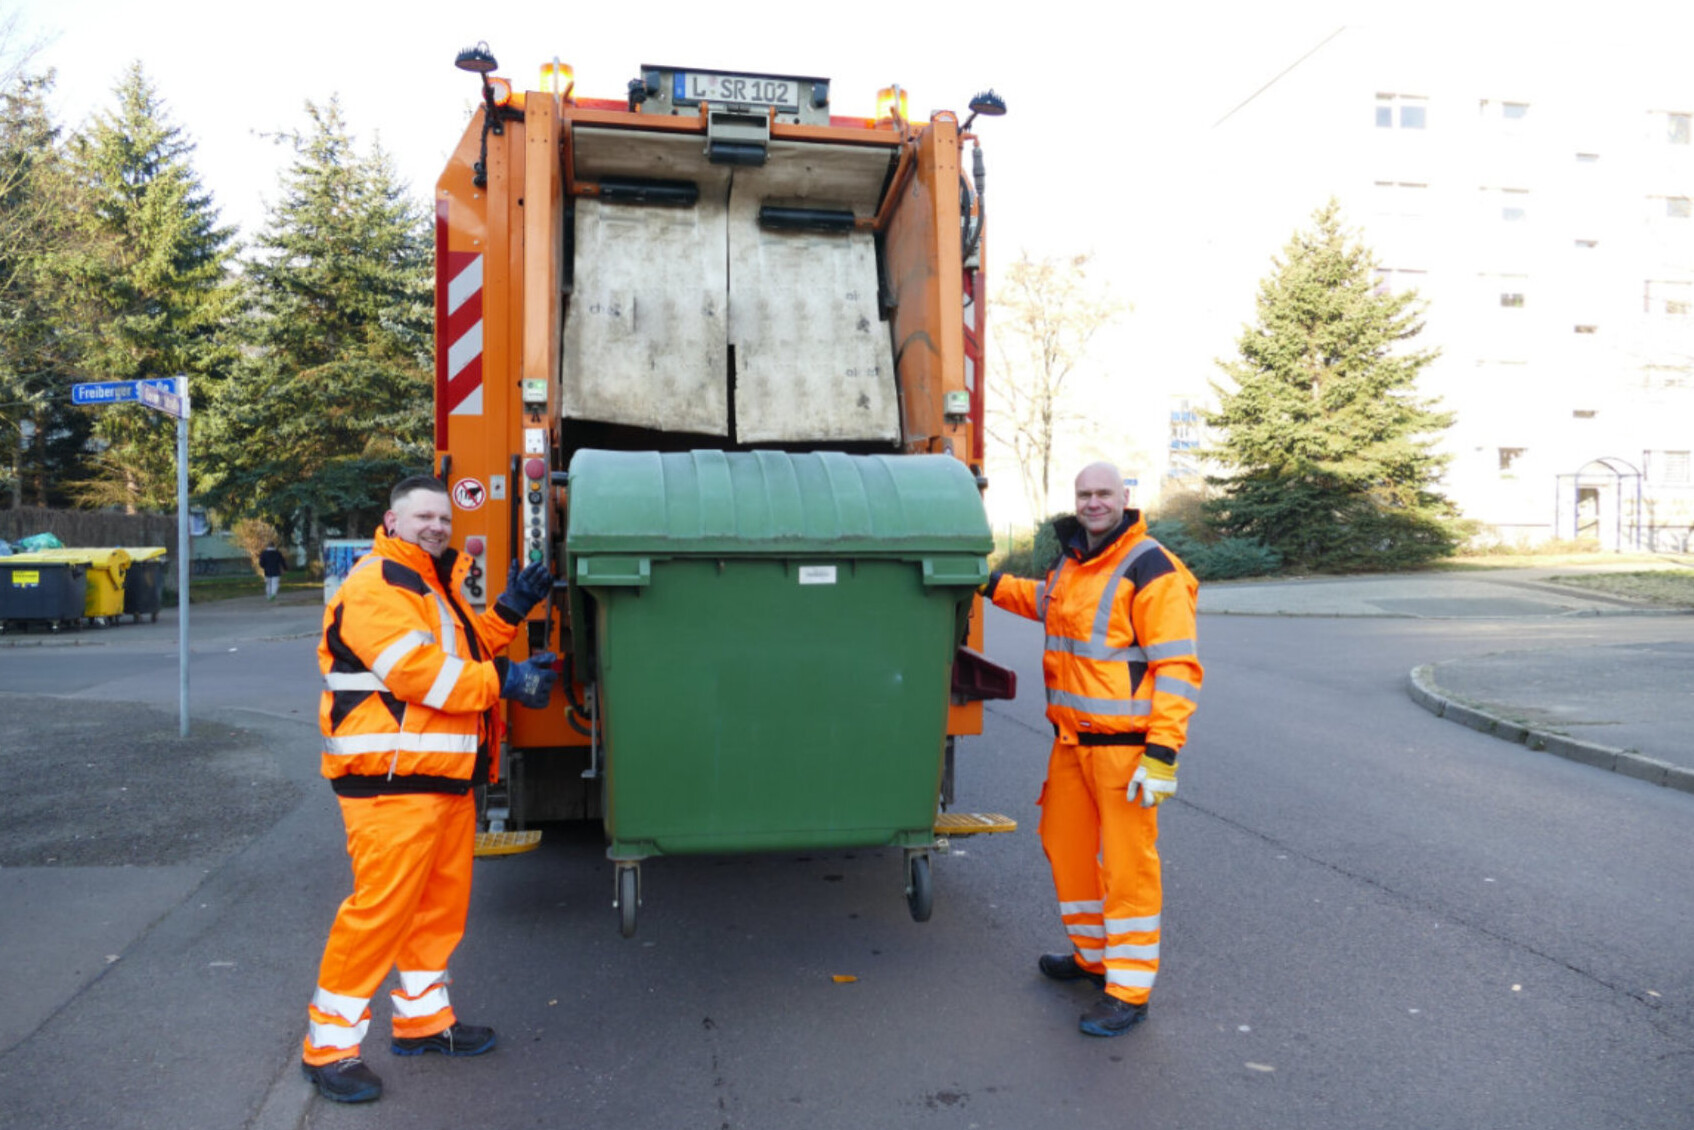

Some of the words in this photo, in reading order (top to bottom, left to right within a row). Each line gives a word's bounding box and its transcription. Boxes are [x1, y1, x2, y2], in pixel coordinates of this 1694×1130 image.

[693, 77, 706, 97] L
[720, 79, 746, 100] SR
[751, 82, 788, 103] 102
